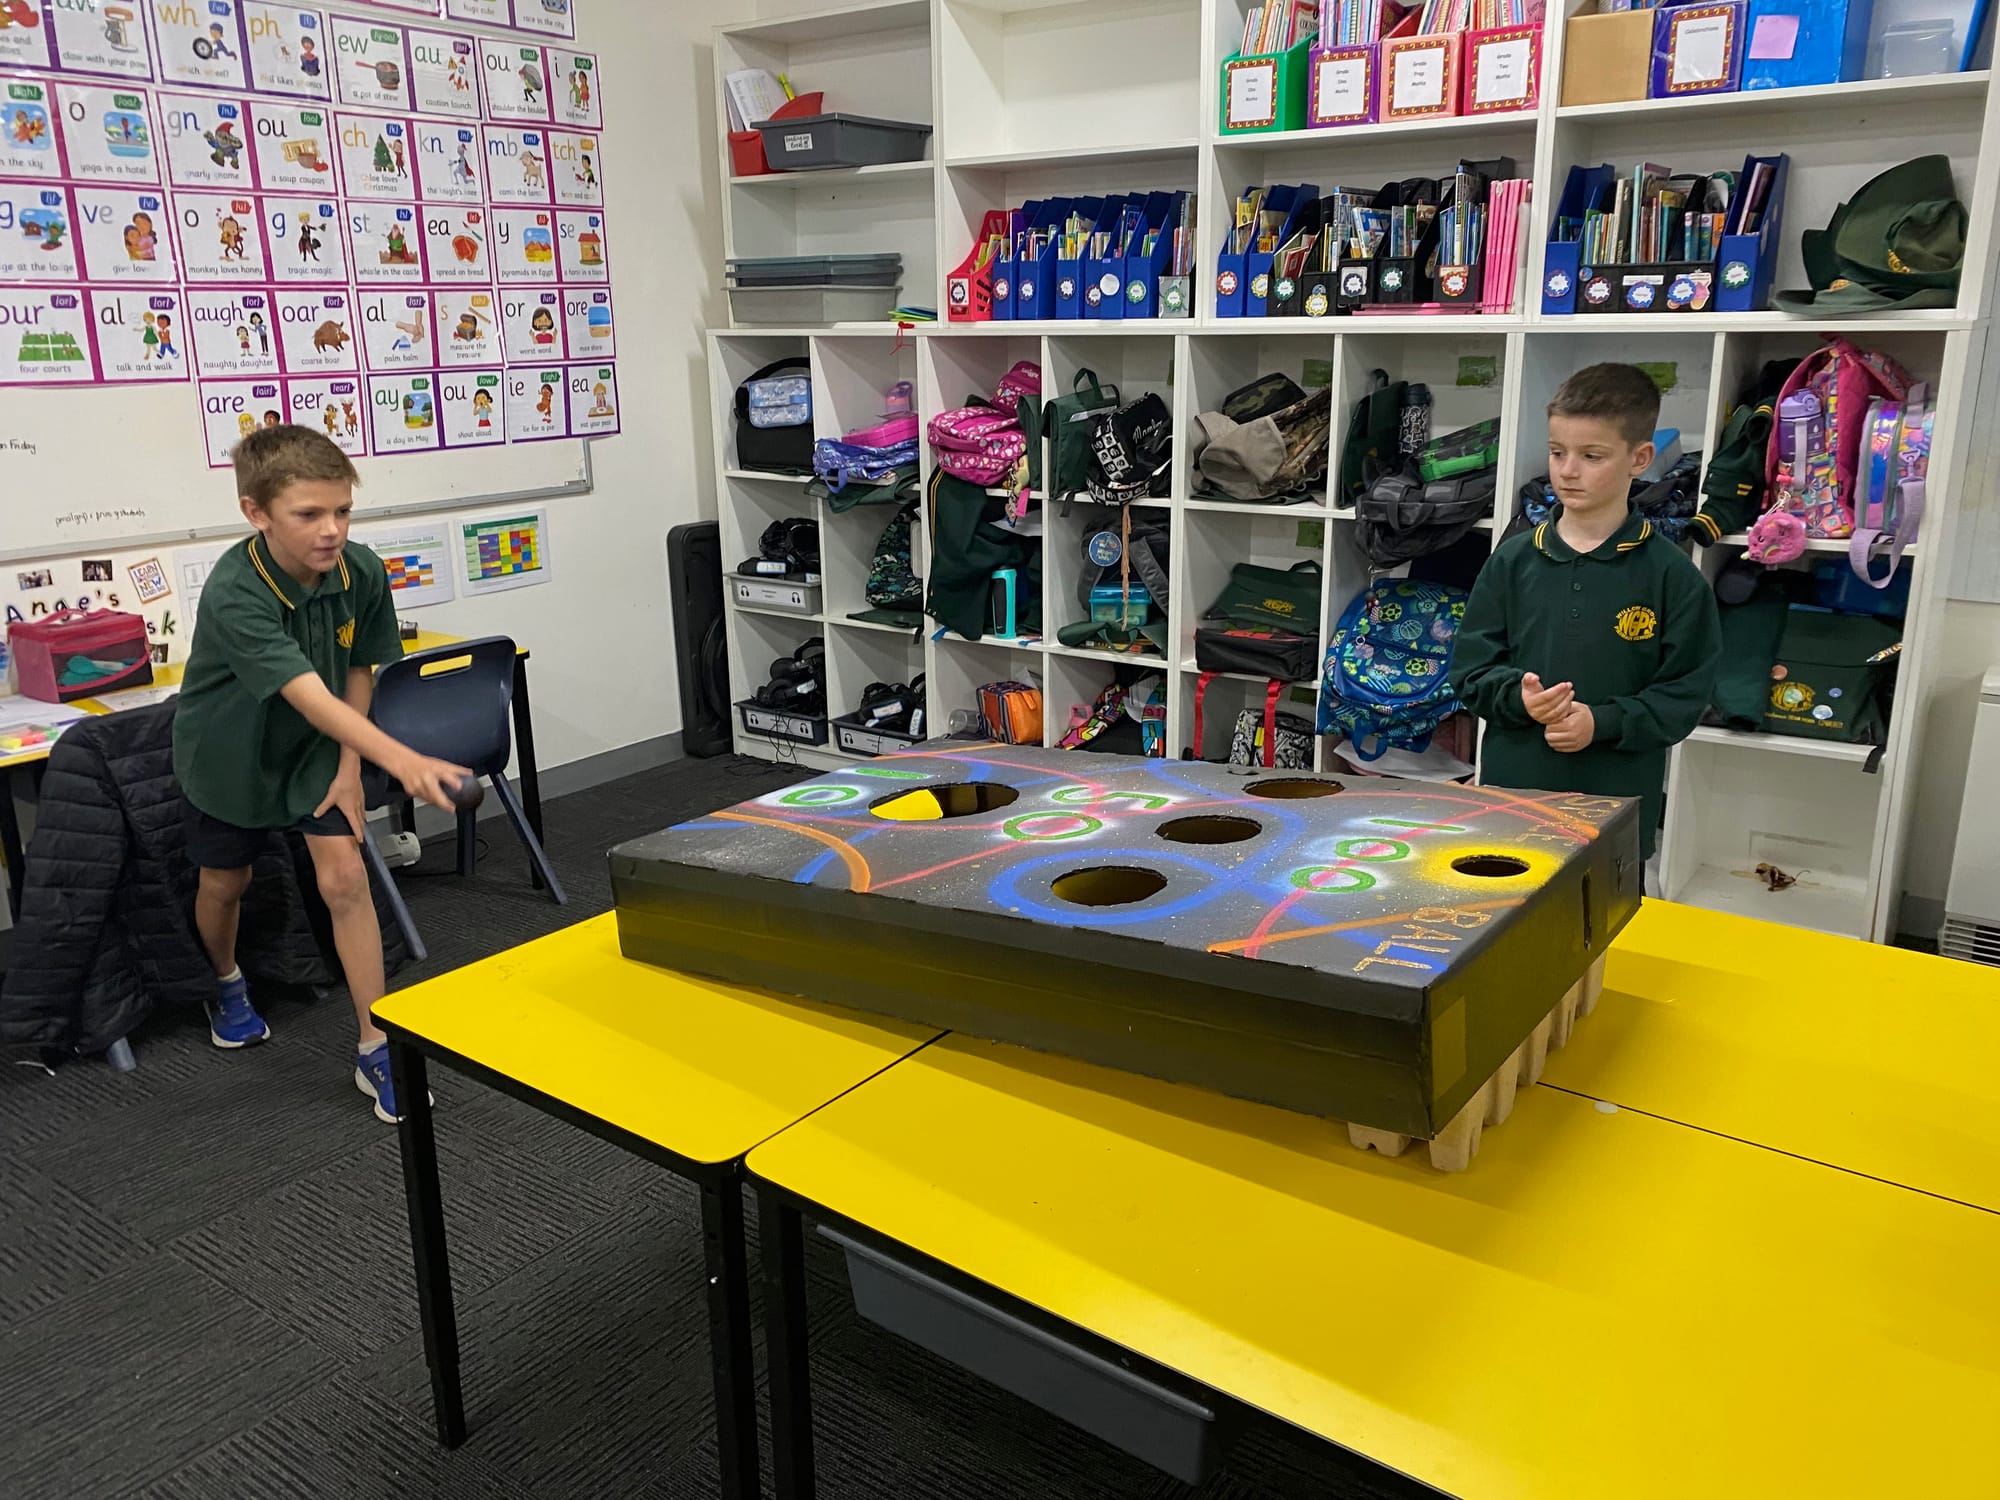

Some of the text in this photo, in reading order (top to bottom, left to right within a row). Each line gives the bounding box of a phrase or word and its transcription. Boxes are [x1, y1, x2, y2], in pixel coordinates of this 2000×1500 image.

[157, 0, 199, 27] wh
[250, 10, 281, 43] ph
[338, 34, 368, 55] ew
[86, 55, 104, 64] with
[414, 45, 442, 65] au
[486, 54, 511, 72] ou
[554, 56, 560, 78] i
[69, 102, 85, 121] o
[167, 110, 201, 138] gn
[257, 118, 288, 138] ou
[343, 122, 368, 148] ch
[418, 128, 444, 154] kn
[489, 133, 518, 157] mb
[552, 138, 577, 161] tch
[27, 159, 44, 170] sky
[125, 166, 147, 175] hotel
[279, 175, 297, 184] soup
[381, 175, 398, 183] loves
[81, 204, 114, 224] ve
[184, 209, 199, 228] o
[353, 213, 371, 233] st
[272, 212, 286, 238] g
[428, 219, 451, 236] ea
[499, 222, 510, 244] y
[560, 223, 575, 239] se
[31, 262, 46, 271] the
[188, 266, 263, 276] monkey loves honey
[287, 266, 333, 276] tragic magic
[501, 268, 530, 277] pyramids
[100, 297, 125, 325] al
[194, 300, 244, 327] augh
[282, 304, 319, 323] oar
[366, 297, 386, 321] al
[440, 305, 448, 320] s
[505, 302, 525, 318] or
[567, 301, 588, 316] ore
[19, 364, 72, 373] four courts
[116, 363, 173, 372] talk and walk
[203, 359, 273, 370] naughty daughter
[301, 357, 323, 365] coarse
[384, 356, 400, 364] palm
[256, 386, 273, 397] /air/
[333, 382, 350, 393] /ear/
[444, 385, 467, 401] ou
[509, 376, 525, 396] ie
[572, 378, 590, 393] ea
[207, 395, 245, 414] are
[292, 393, 324, 410] eer
[375, 389, 399, 412] ay
[9, 438, 36, 456] Friday
[393, 437, 406, 445] day
[415, 435, 429, 444] May
[6, 589, 120, 624] Ange's
[146, 611, 176, 636] sk
[1619, 611, 1654, 637] WGPS
[1289, 818, 1467, 894] 100
[1352, 906, 1493, 972] BALL
